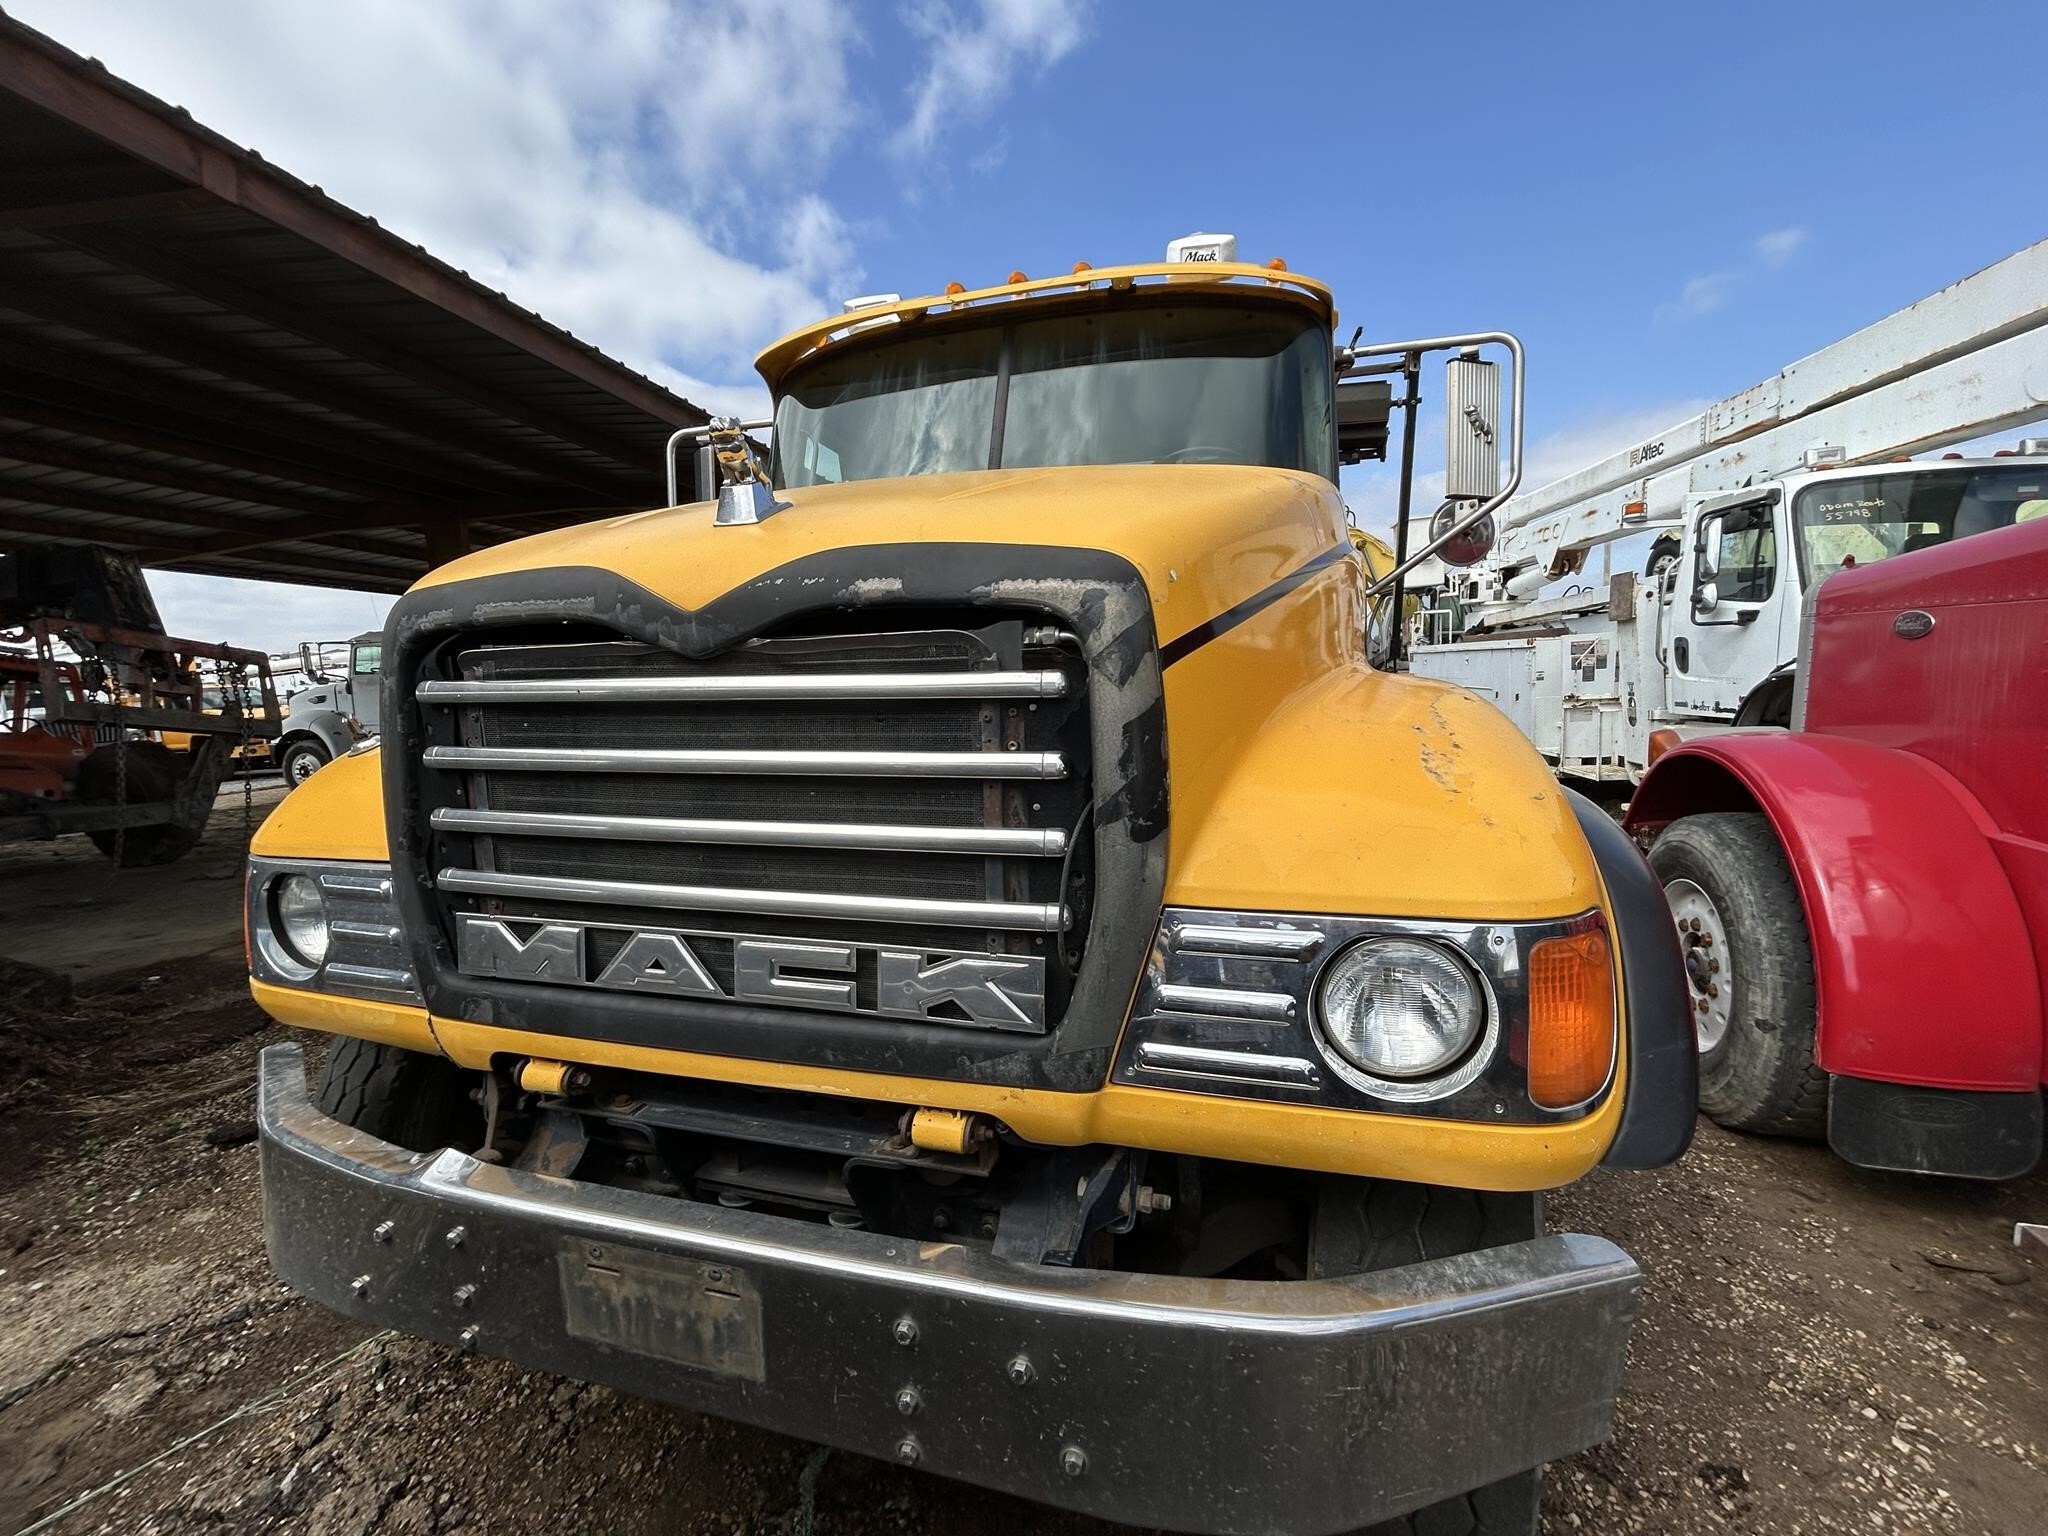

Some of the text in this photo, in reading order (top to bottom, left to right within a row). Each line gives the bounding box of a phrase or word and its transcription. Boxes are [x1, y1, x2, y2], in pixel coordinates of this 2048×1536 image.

[1185, 249, 1218, 262] Mack
[1639, 442, 1664, 464] Altec
[456, 912, 1046, 1034] MACK
